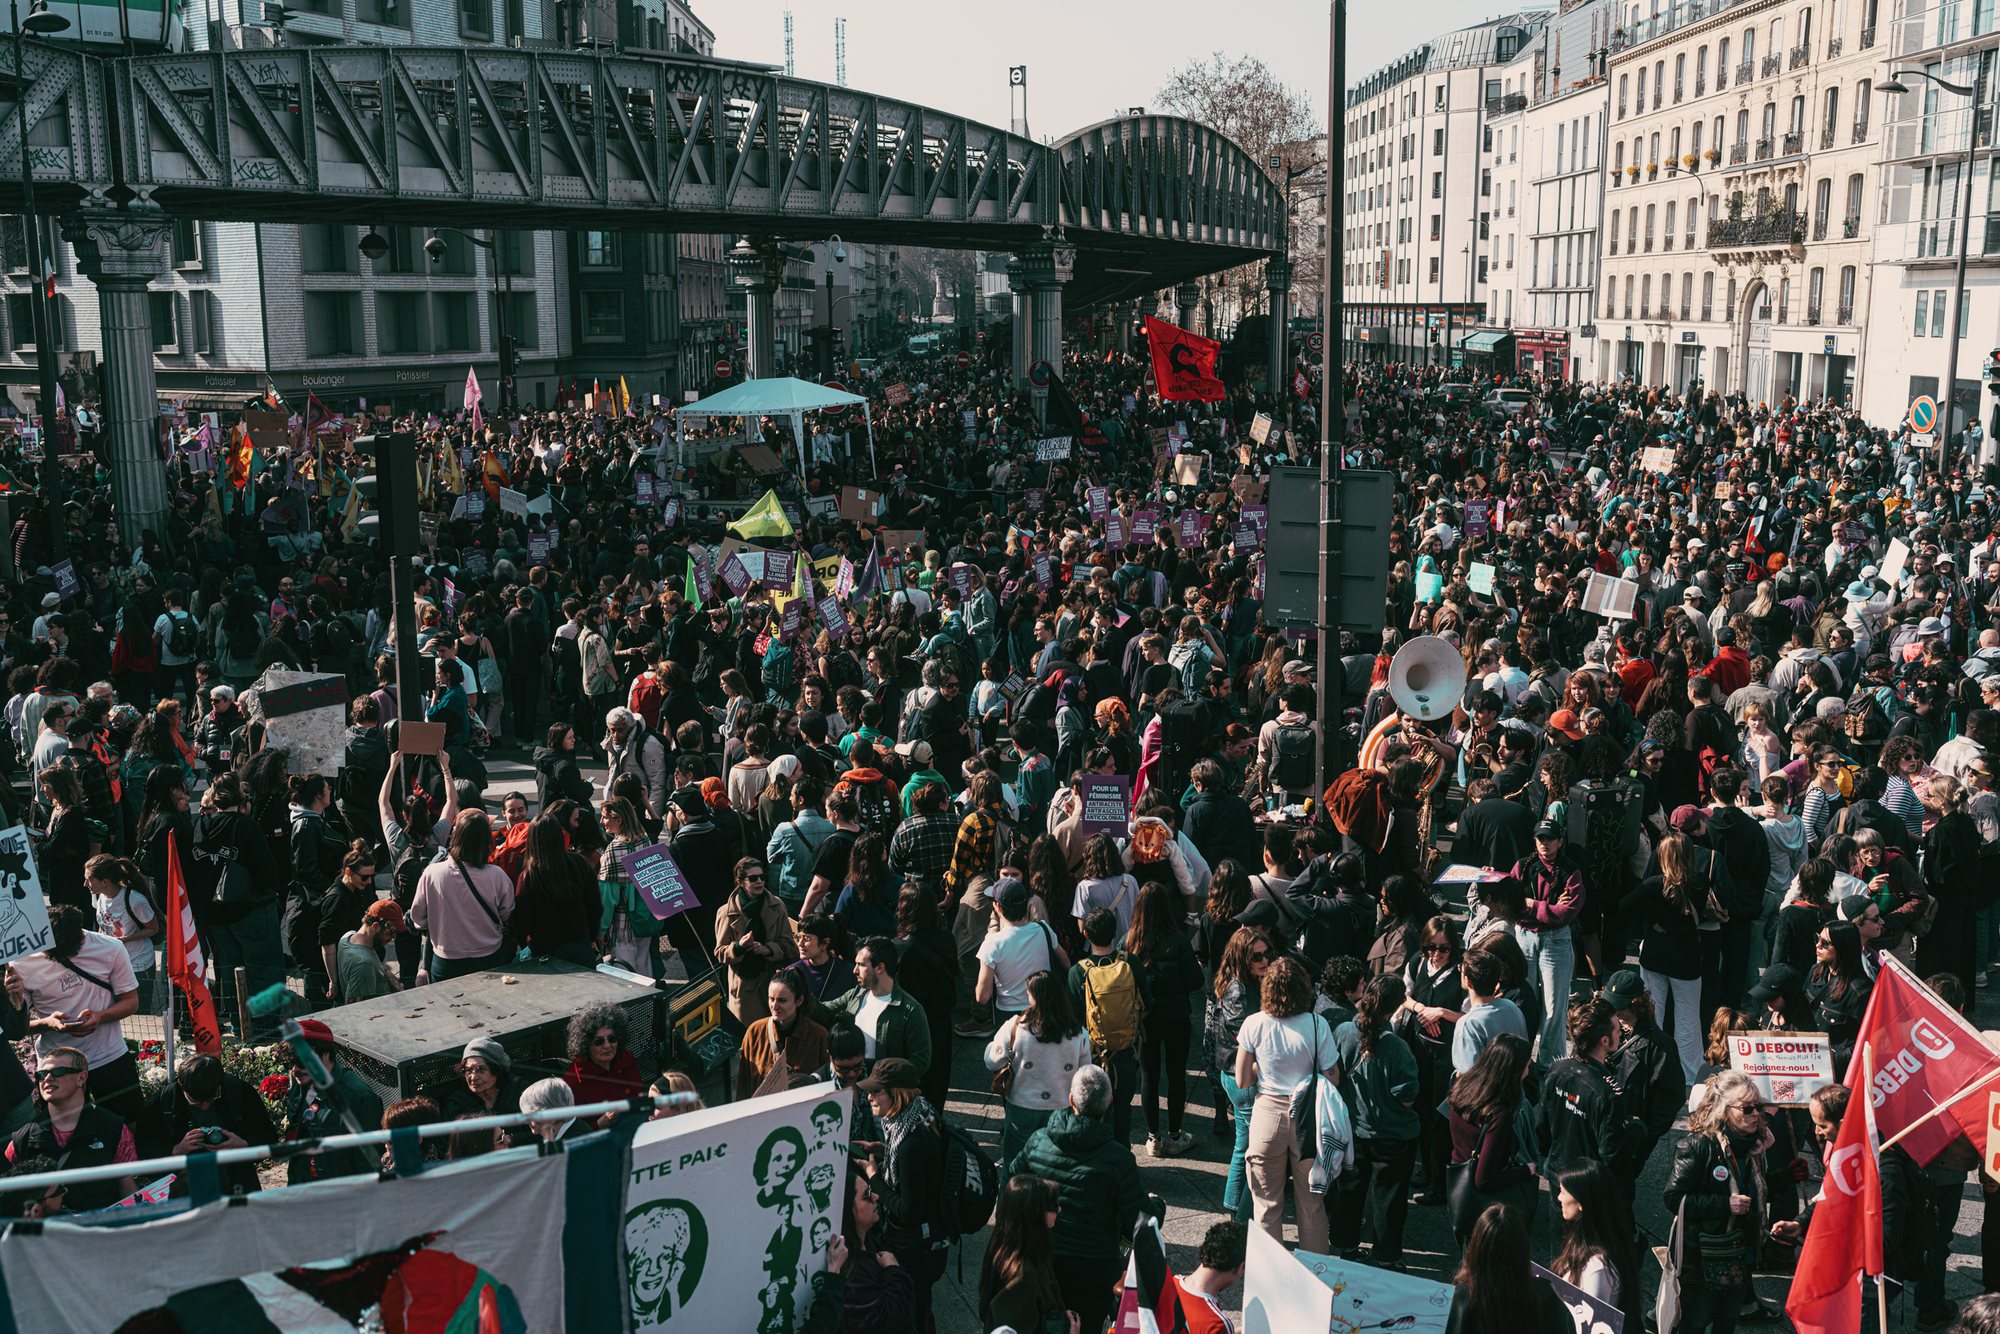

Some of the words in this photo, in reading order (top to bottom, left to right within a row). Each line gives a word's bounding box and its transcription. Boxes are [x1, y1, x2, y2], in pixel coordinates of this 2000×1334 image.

[1312, 338, 1322, 346] 30
[396, 370, 430, 380] Pâtissier
[205, 376, 237, 386] Pâtissier
[302, 375, 345, 387] Boulanger
[635, 853, 662, 869] HANDIES
[196, 1026, 215, 1046] CGT
[1756, 1043, 1819, 1053] DEBOUT!
[1744, 1064, 1809, 1072] Rejoignez-nous
